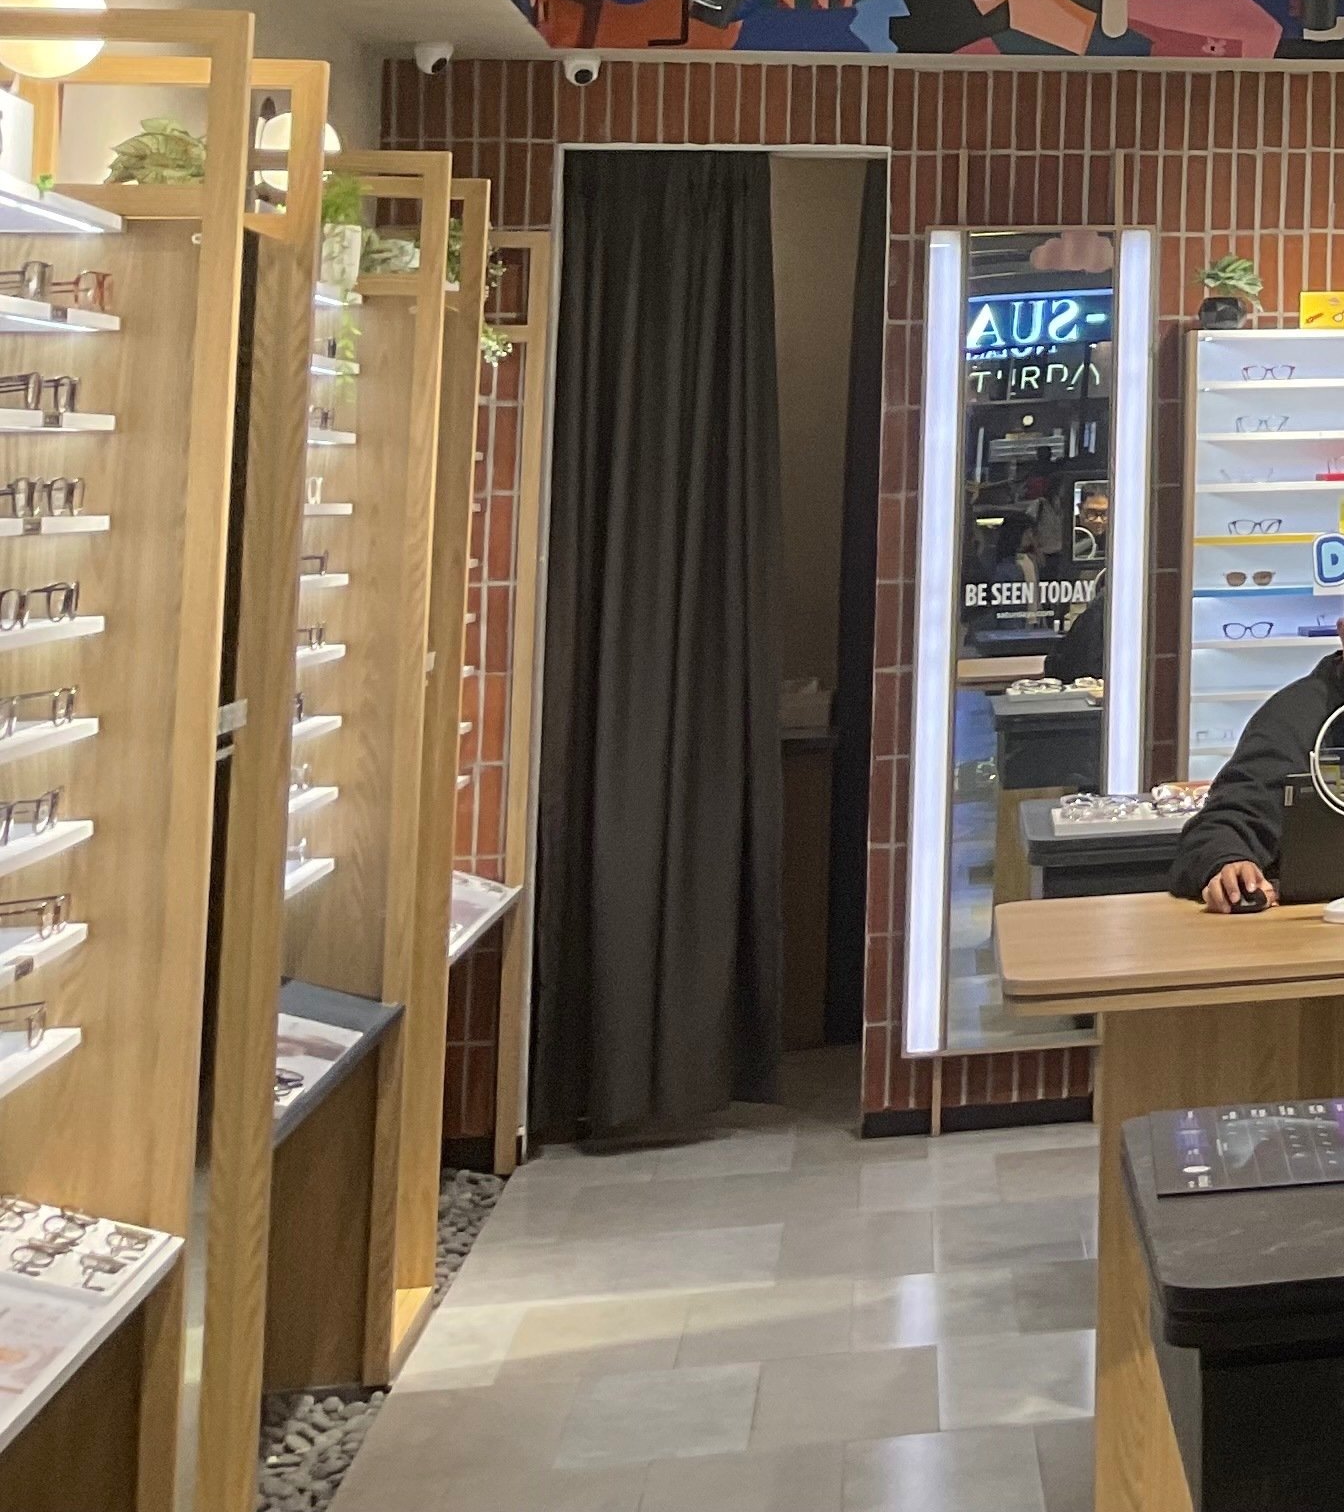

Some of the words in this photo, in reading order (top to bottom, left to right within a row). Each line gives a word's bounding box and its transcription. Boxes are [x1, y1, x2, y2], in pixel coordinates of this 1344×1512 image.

[965, 583, 987, 606] BE
[991, 582, 1034, 605] SEEN
[1039, 579, 1098, 604] TODAY
